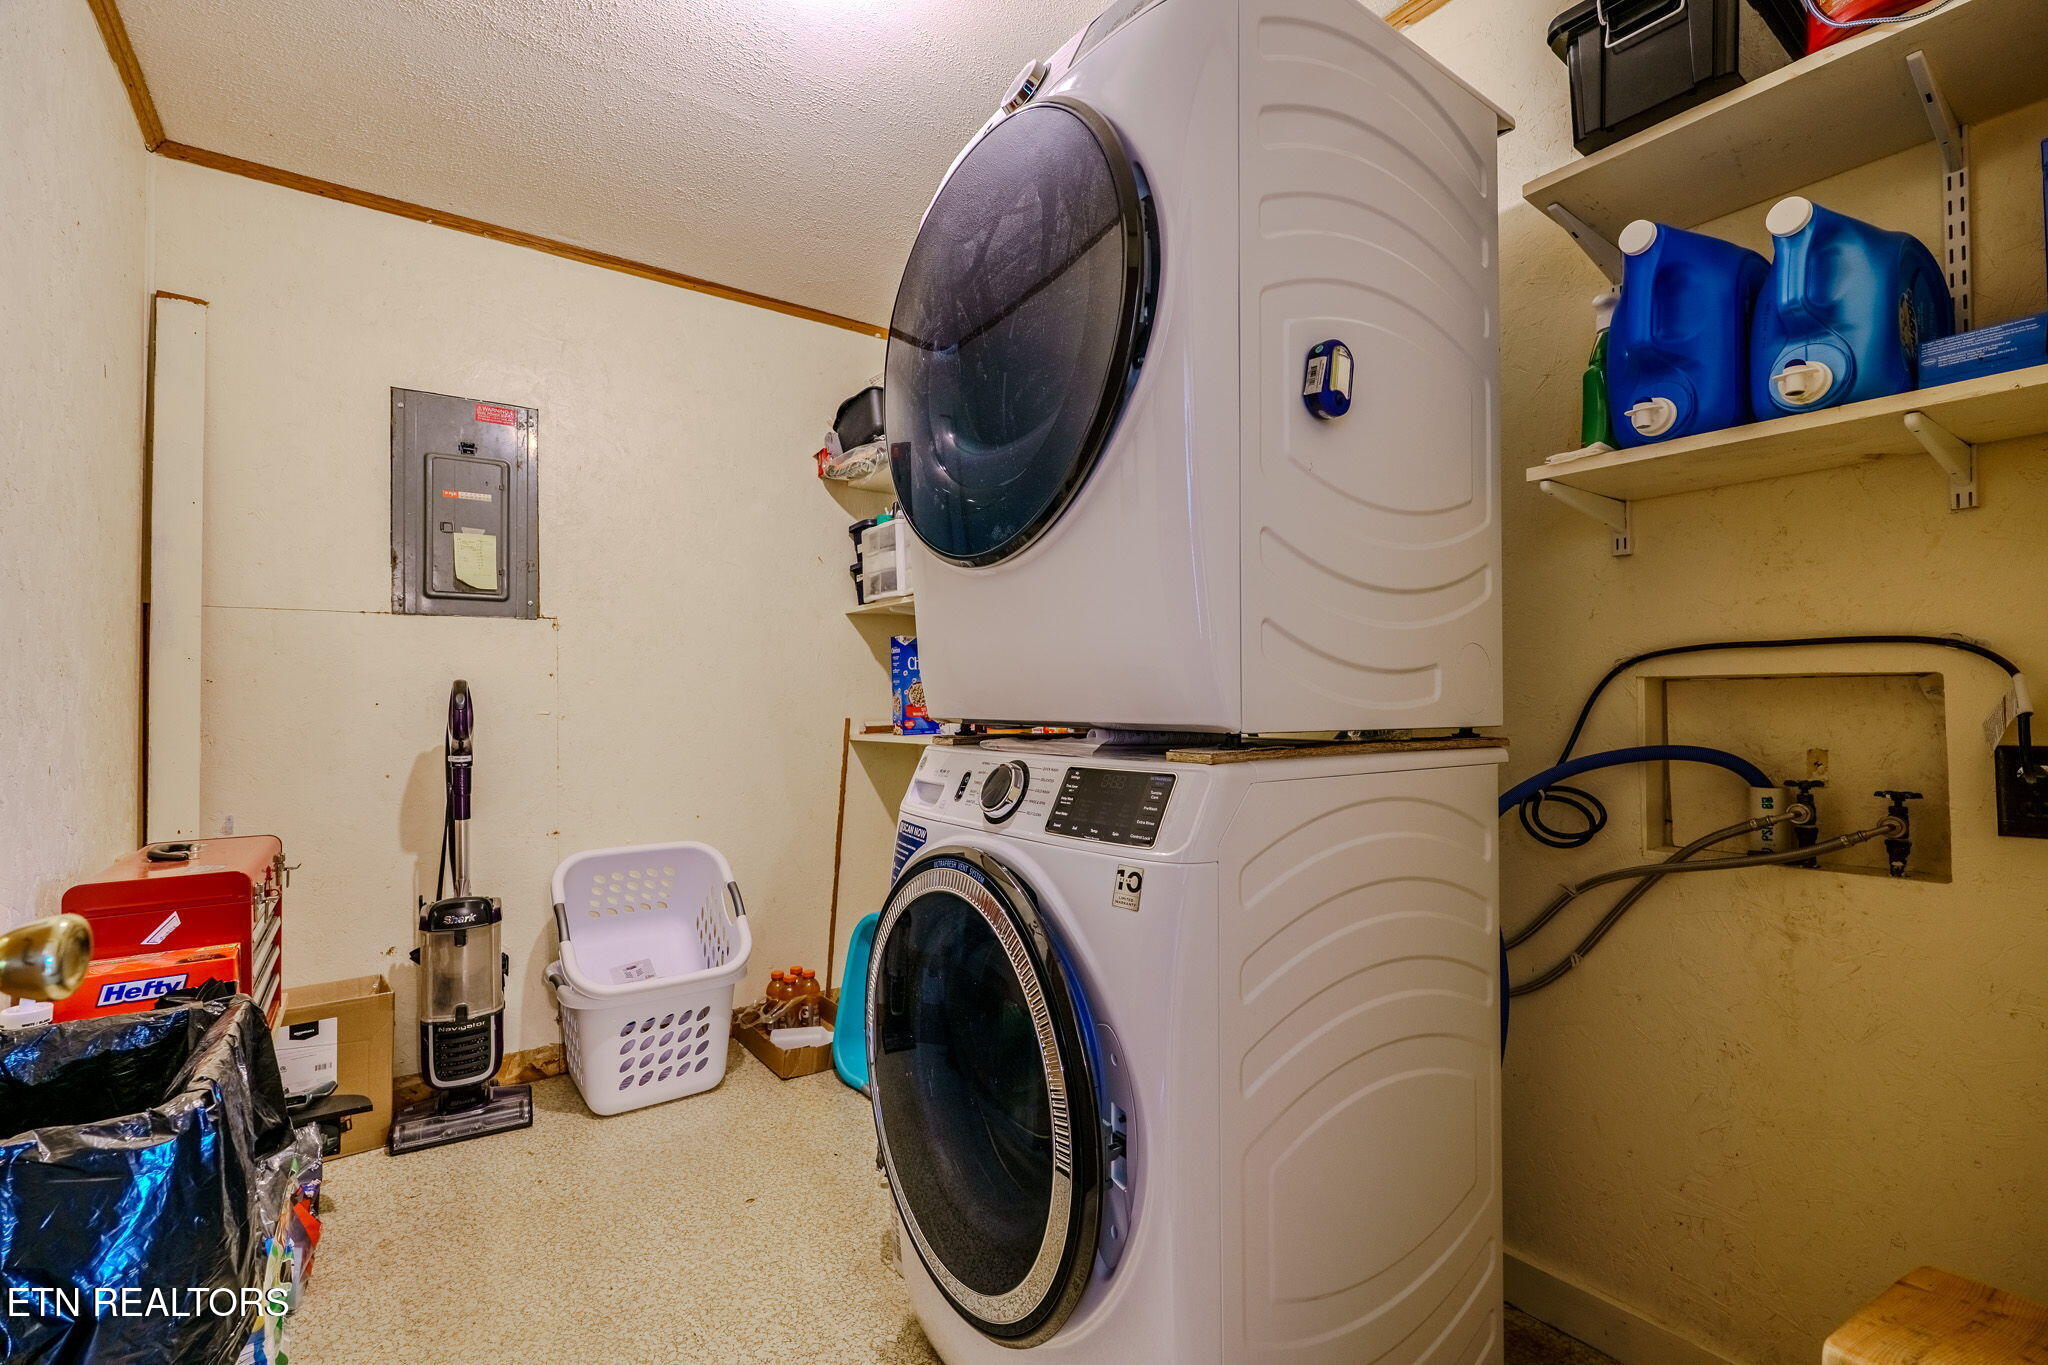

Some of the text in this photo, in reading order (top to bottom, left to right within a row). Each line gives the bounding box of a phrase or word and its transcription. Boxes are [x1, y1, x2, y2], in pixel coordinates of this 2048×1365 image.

[957, 862, 969, 872] VENT
[969, 867, 985, 884] SYSTEM
[1116, 869, 1143, 894] 10
[442, 912, 477, 925] Shark
[102, 980, 183, 1003] Hefty
[437, 1020, 486, 1033] Navigator
